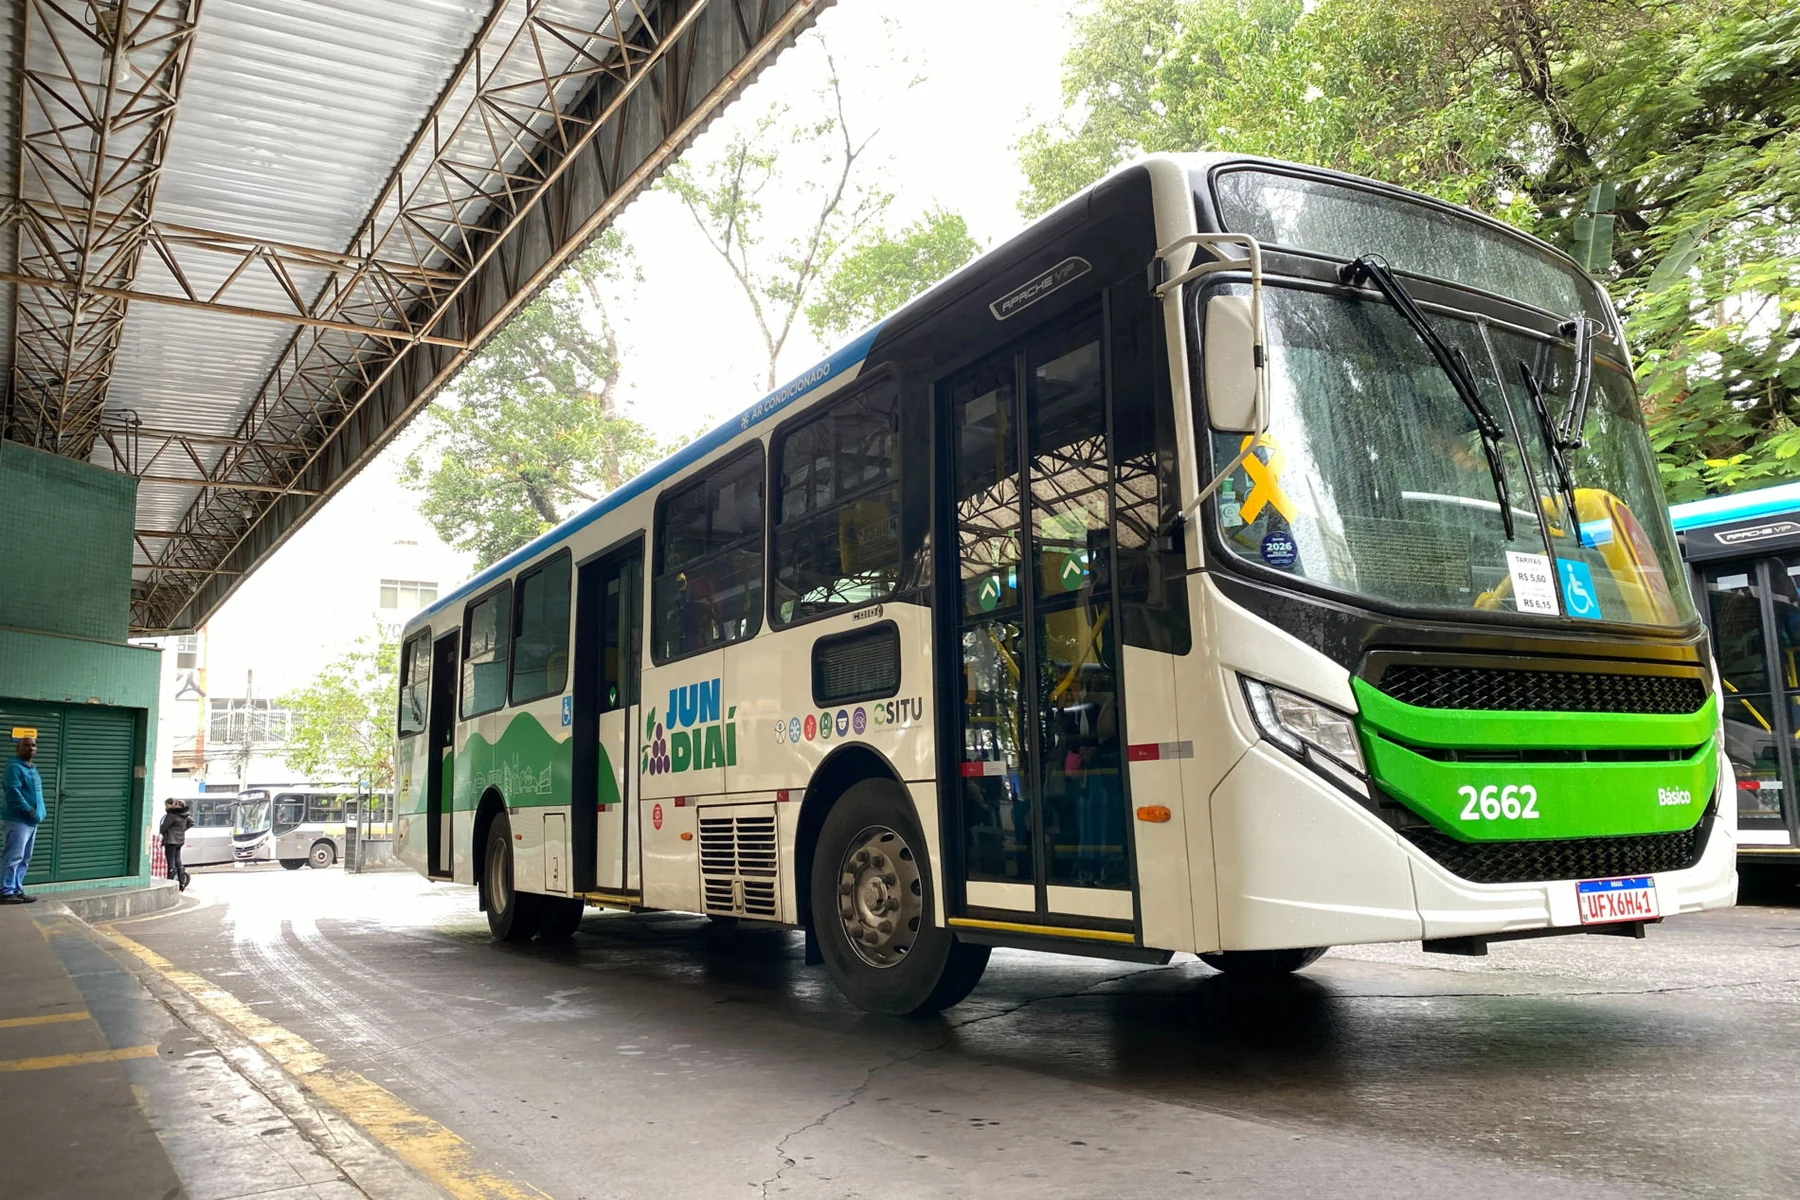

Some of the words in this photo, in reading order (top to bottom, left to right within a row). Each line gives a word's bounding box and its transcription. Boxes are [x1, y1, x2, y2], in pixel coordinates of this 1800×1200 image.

[1002, 276, 1053, 312] APACHE
[1055, 263, 1075, 281] VIP
[751, 407, 763, 420] AR
[764, 363, 830, 412] CONDICIONADO
[1726, 528, 1772, 540] APACHE
[1774, 525, 1792, 533] VIP
[1266, 542, 1292, 552] 2026
[1516, 557, 1542, 565] TARIFAS
[1530, 574, 1546, 584] 5,60
[1535, 601, 1552, 610] 6,15
[666, 678, 720, 730] JUN
[886, 697, 922, 724] SITU
[671, 706, 737, 773] DIAÍ
[1458, 785, 1539, 820] 2662
[1658, 785, 1691, 806] Básico
[1587, 890, 1652, 918] UFX6H41
